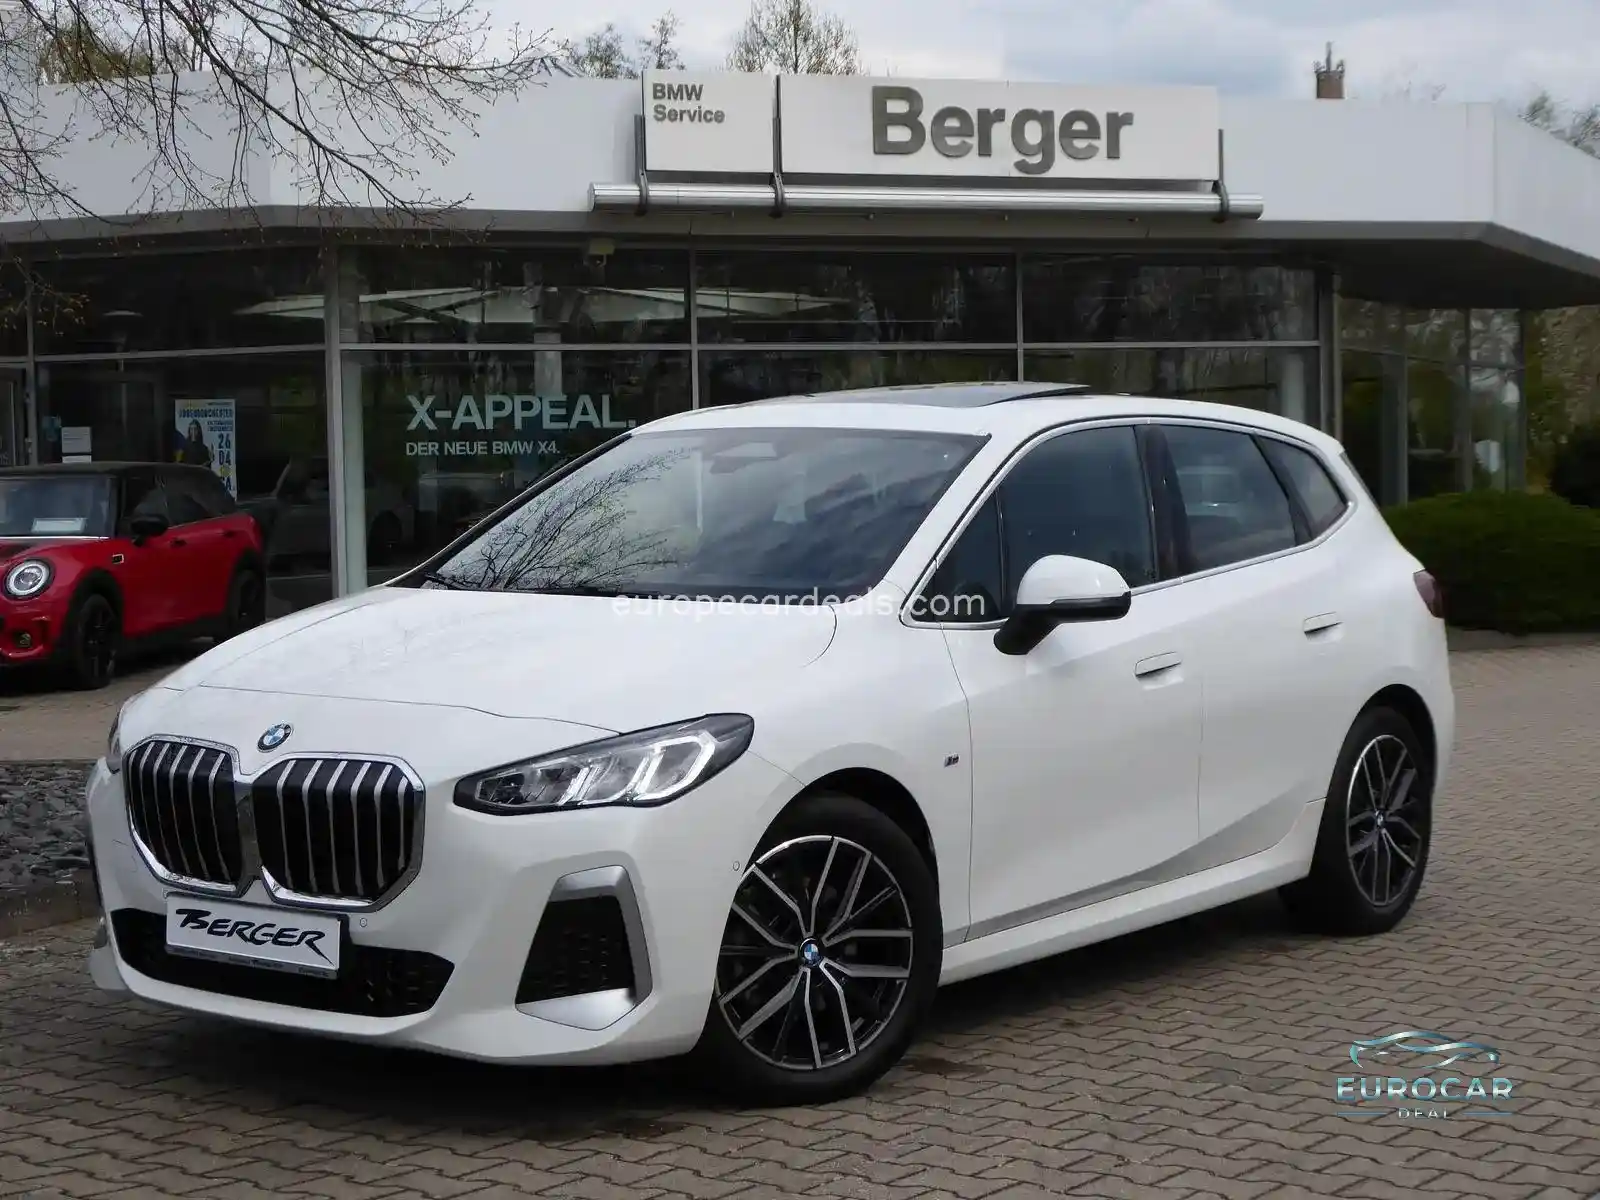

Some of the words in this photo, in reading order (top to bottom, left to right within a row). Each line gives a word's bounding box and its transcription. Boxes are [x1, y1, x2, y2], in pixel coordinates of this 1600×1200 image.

[652, 82, 703, 102] BMW
[653, 103, 726, 125] Service
[871, 85, 1134, 175] Berger
[406, 394, 637, 431] X-APPEAL.
[217, 433, 231, 449] 26
[406, 441, 439, 456] DER
[444, 440, 488, 456] NEUE
[492, 440, 535, 455] BMW
[537, 440, 561, 454] X4.
[218, 450, 231, 465] 04
[175, 908, 335, 967] BERGER
